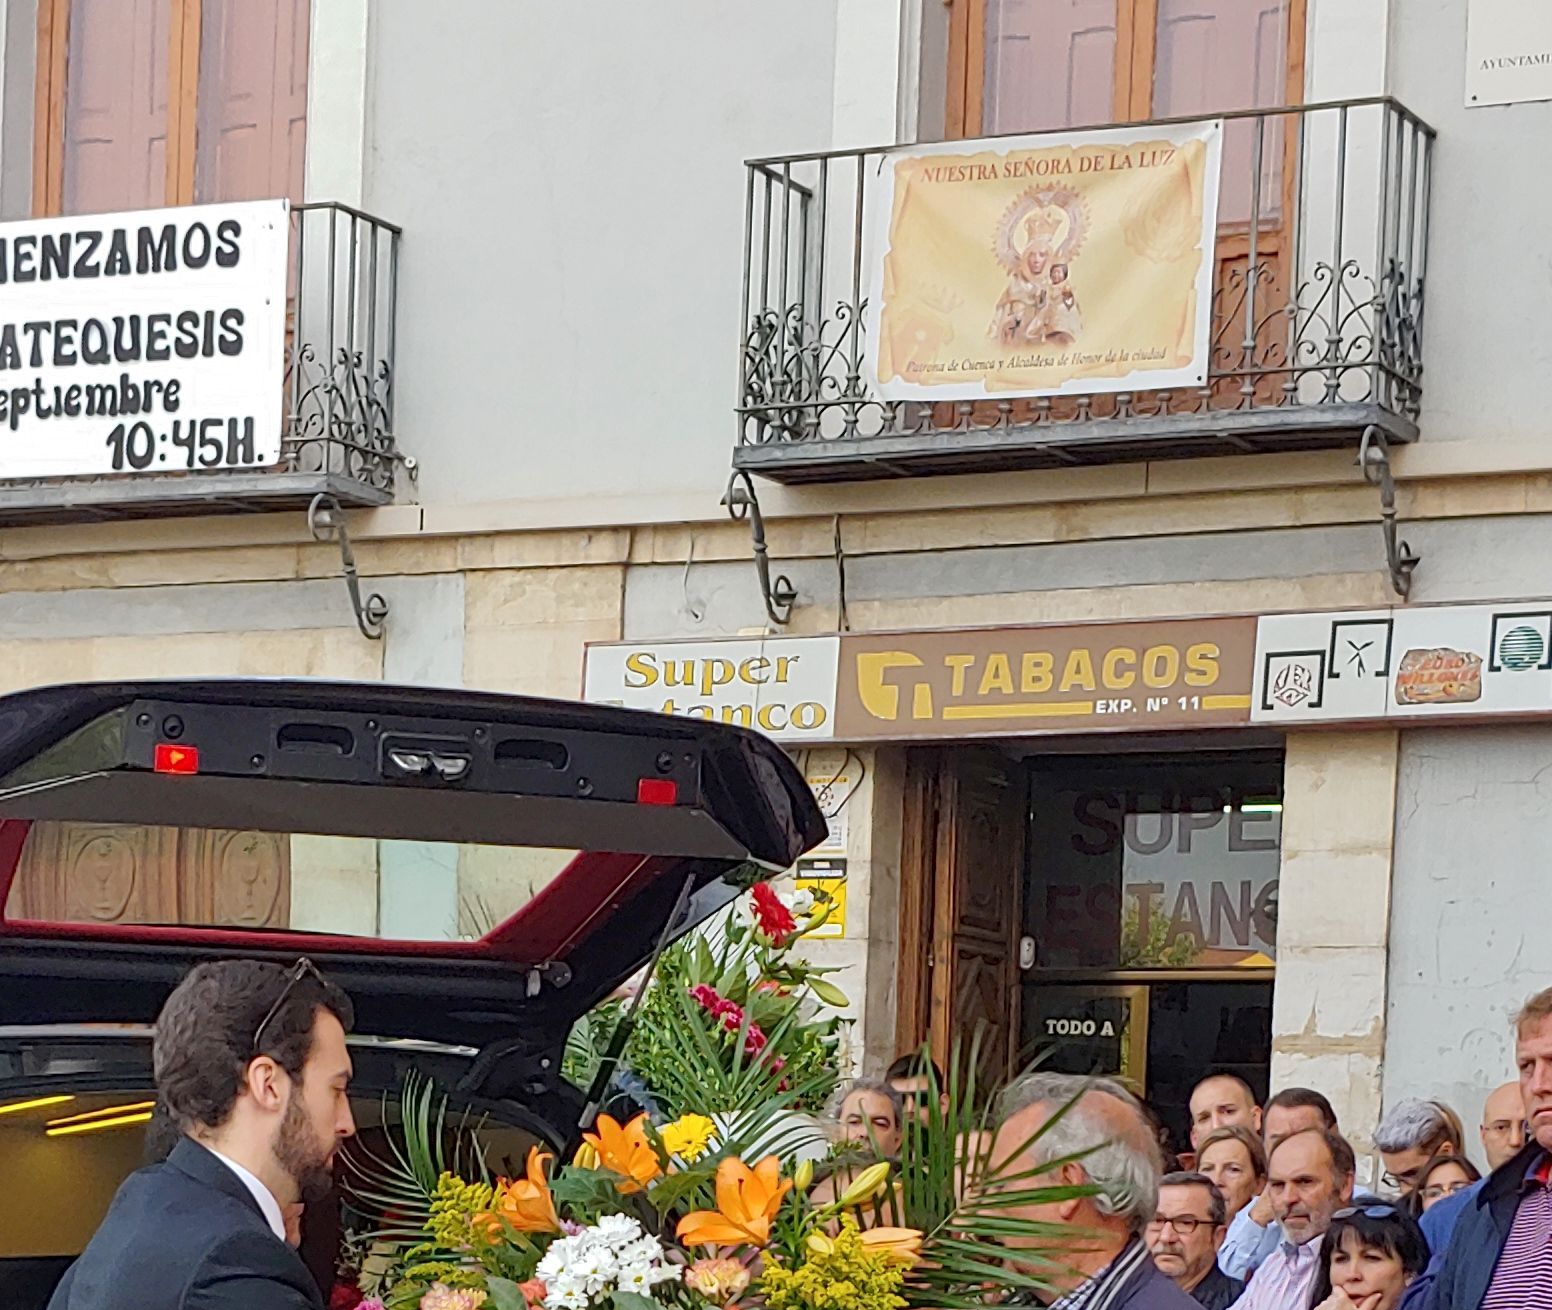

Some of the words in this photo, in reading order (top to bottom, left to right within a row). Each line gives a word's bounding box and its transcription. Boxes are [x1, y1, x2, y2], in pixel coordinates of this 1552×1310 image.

[920, 163, 998, 183] NUESTRA
[1002, 155, 1073, 178] SEÑORA
[1079, 154, 1105, 172] DE
[1109, 153, 1133, 170] LA
[1139, 149, 1176, 168] LUZ
[948, 359, 959, 371] de
[961, 358, 995, 371] Cuenca
[1007, 354, 1055, 369] Alcaldesa
[1057, 354, 1069, 367] de
[624, 651, 800, 697] Super
[944, 642, 1221, 697] TABACOS
[595, 699, 827, 731] tanco
[1096, 697, 1138, 715] EXP.
[1177, 695, 1200, 711] 11
[1071, 783, 1280, 856] SUPE
[1046, 879, 1280, 952] ESTANC
[1046, 1019, 1096, 1036] TODO
[1100, 1020, 1115, 1037] A
